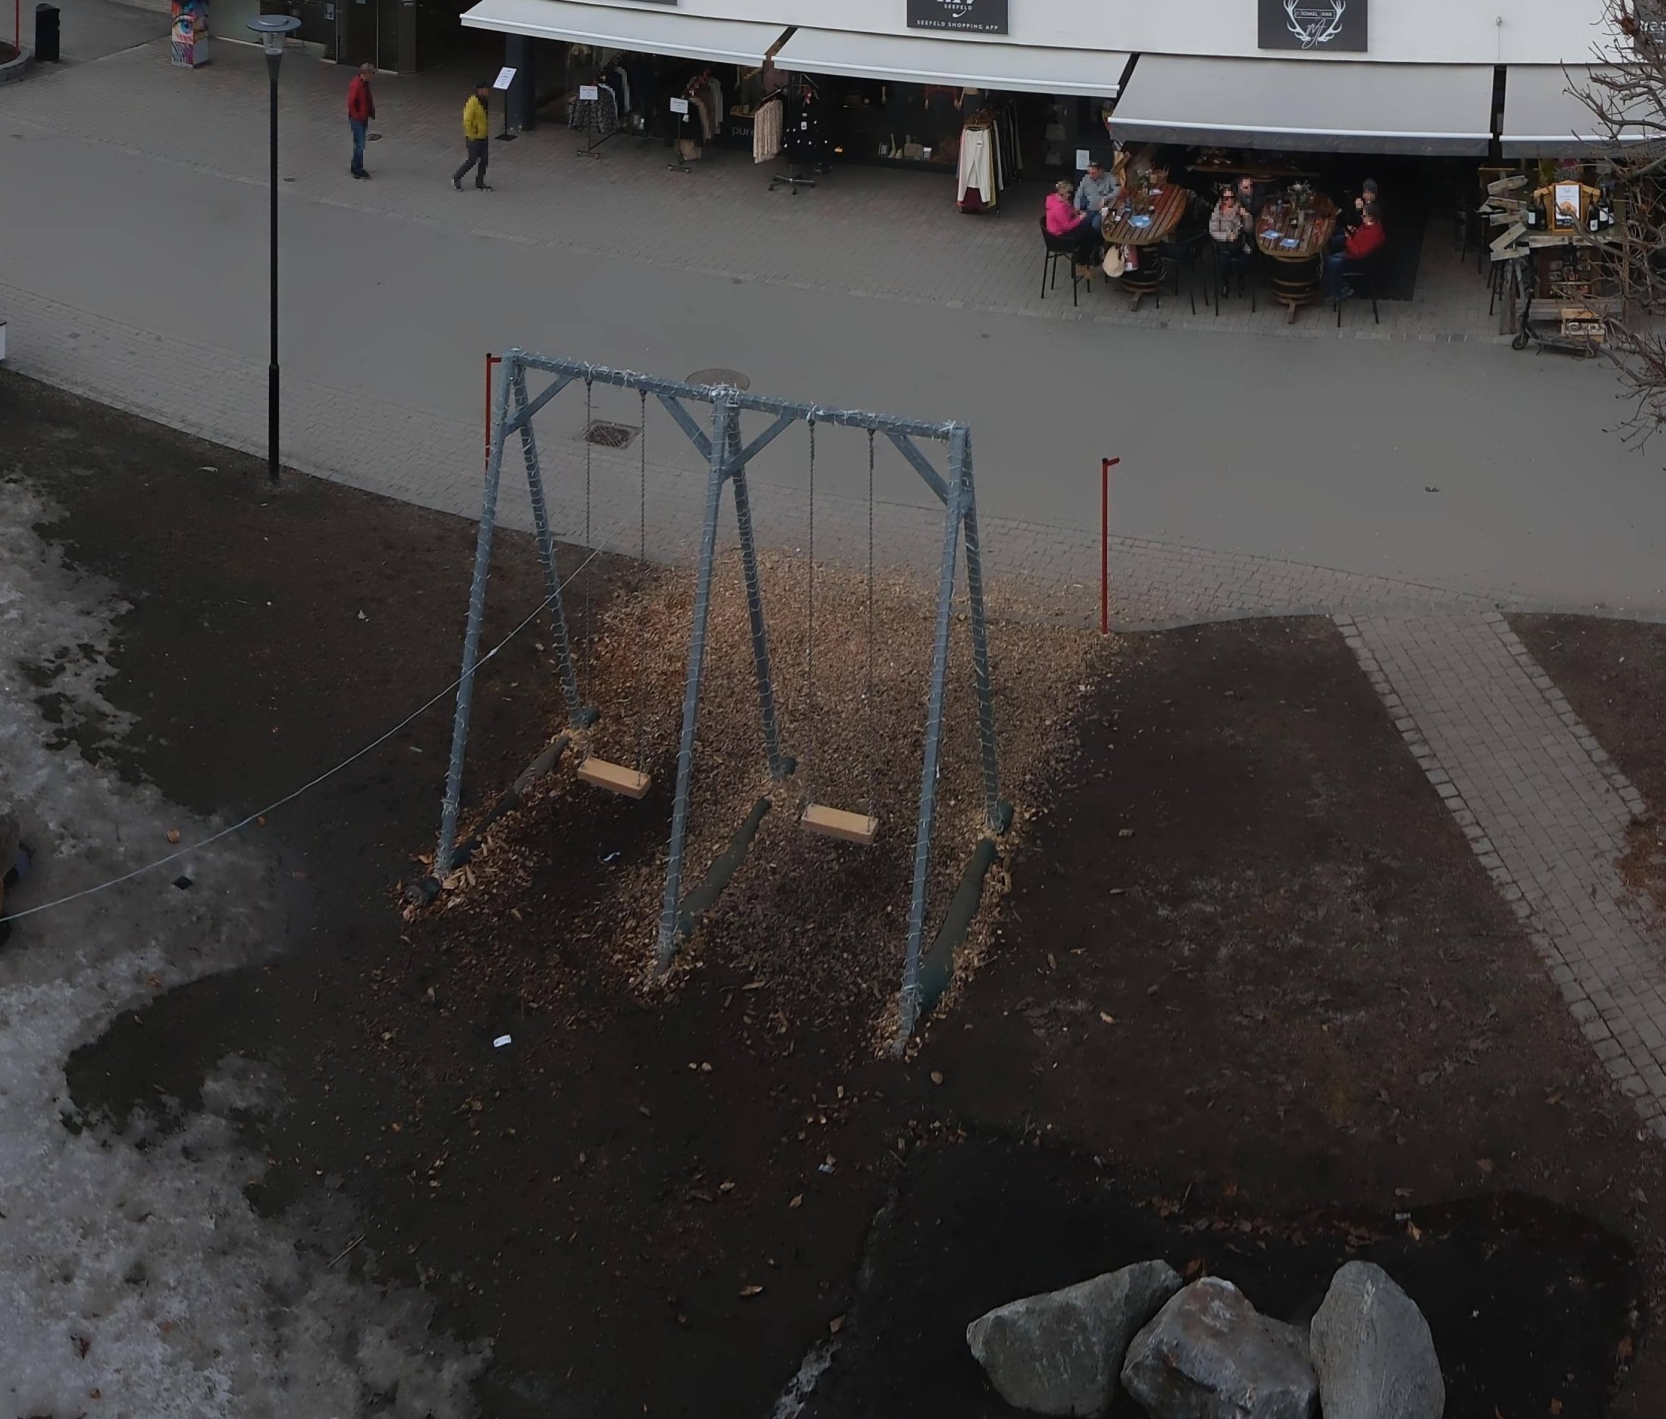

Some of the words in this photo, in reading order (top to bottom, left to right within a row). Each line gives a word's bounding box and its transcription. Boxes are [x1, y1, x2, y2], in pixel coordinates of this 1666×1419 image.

[943, 3, 973, 11] SEEFELD
[916, 19, 946, 27] SEEFELD
[947, 21, 983, 30] SHOPPING
[732, 124, 753, 137] pur
